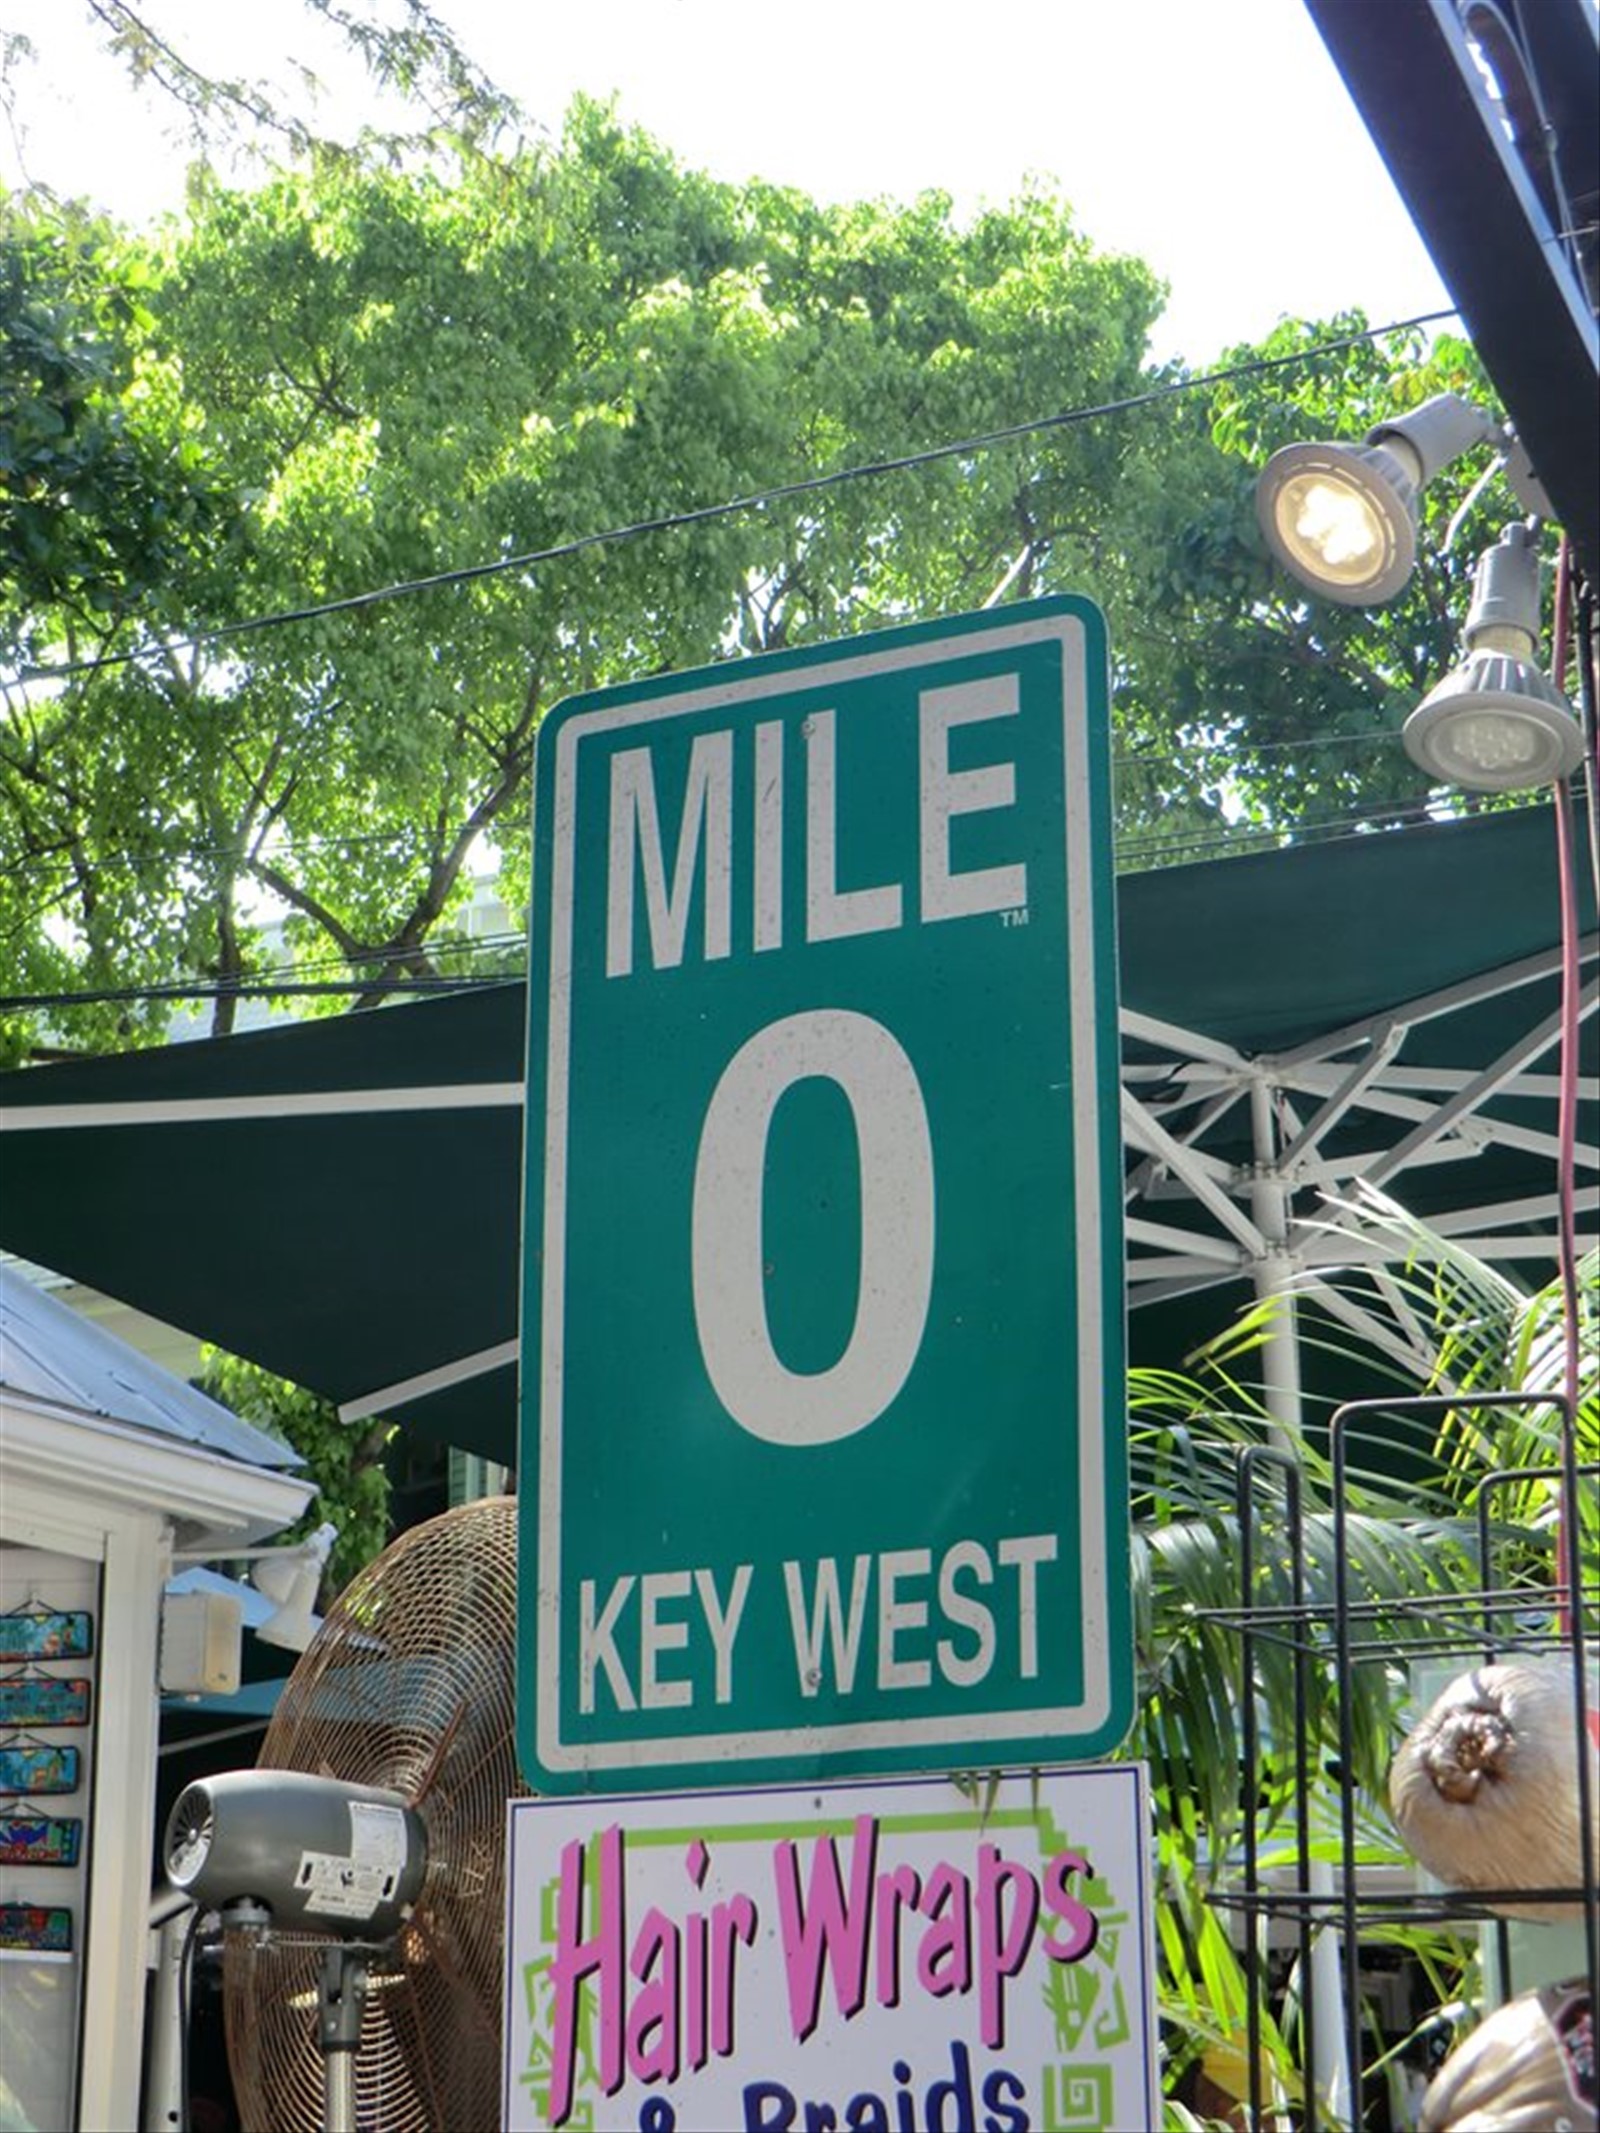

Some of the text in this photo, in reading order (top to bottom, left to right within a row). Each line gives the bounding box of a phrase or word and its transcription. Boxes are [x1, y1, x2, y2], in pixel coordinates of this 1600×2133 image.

[606, 672, 1027, 979] MILE
[999, 908, 1029, 927] TM
[691, 1008, 936, 1447] 0
[579, 1534, 1058, 1715] KEY WEST
[547, 1814, 1098, 2127] Hair Wraps
